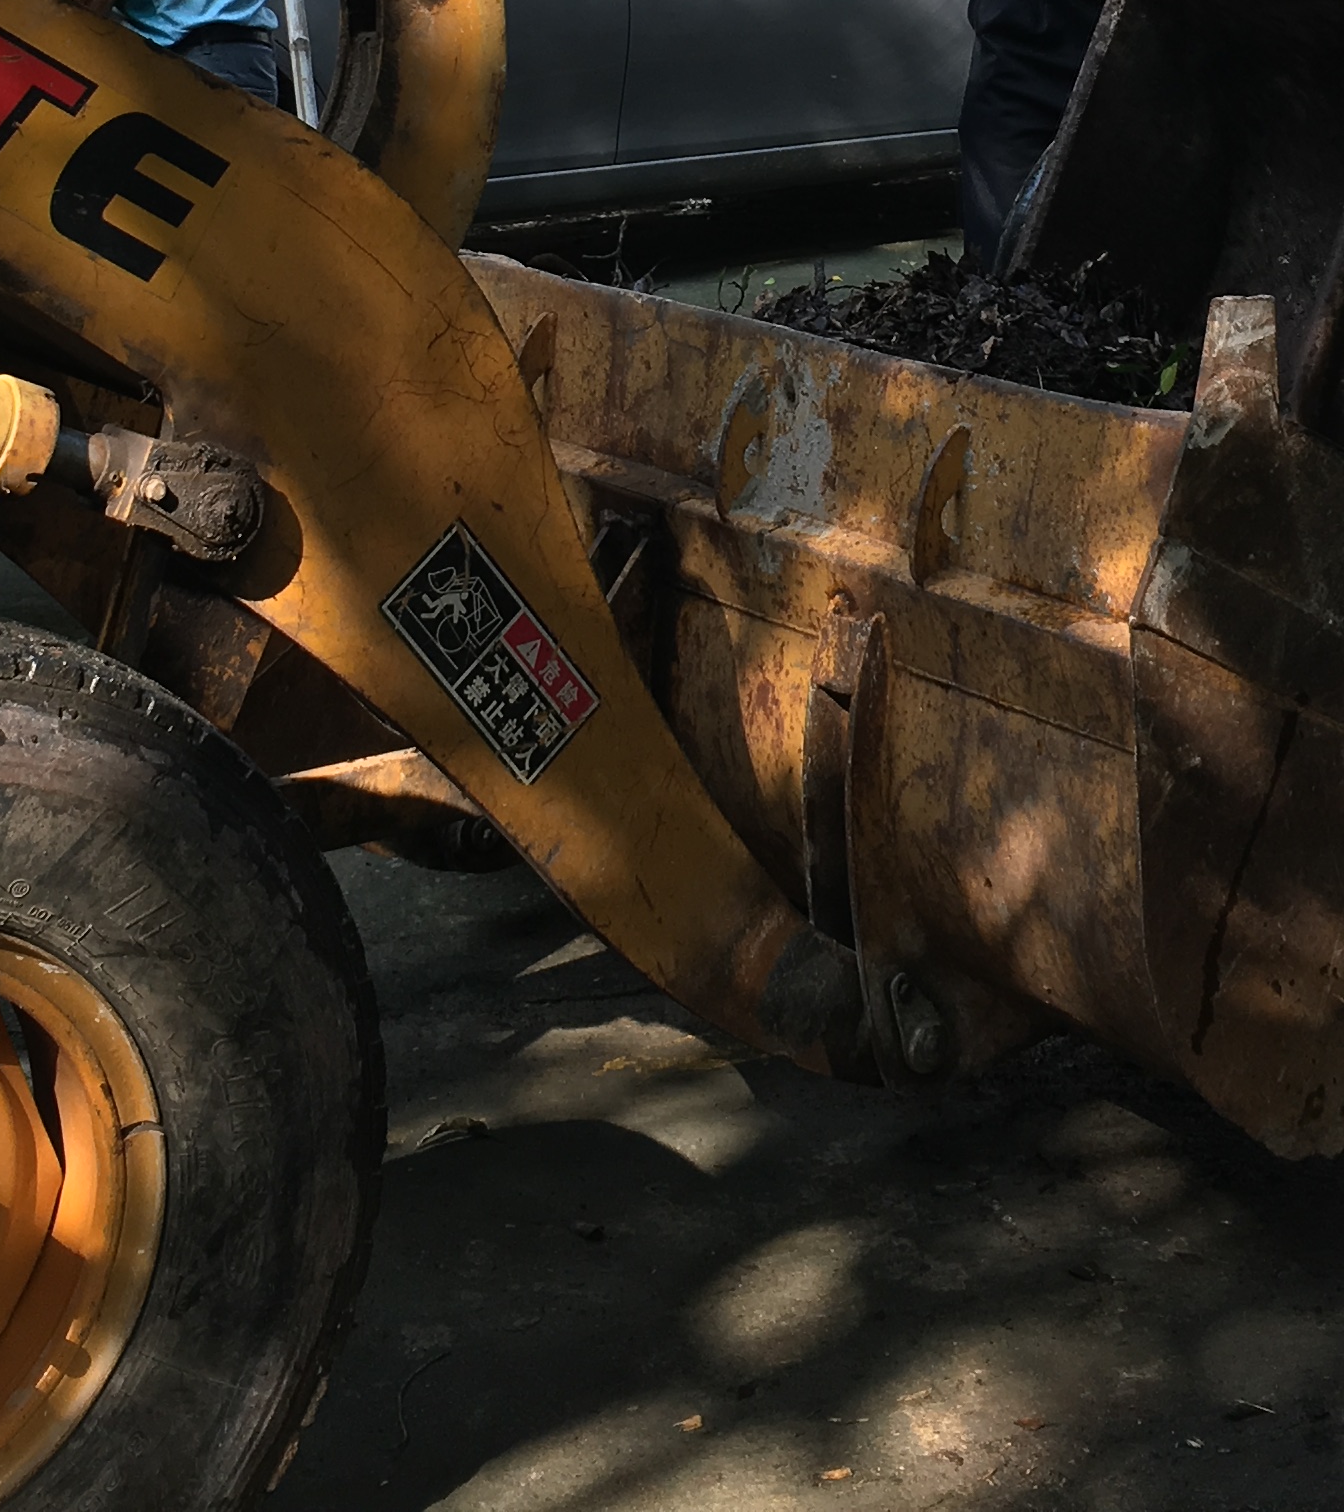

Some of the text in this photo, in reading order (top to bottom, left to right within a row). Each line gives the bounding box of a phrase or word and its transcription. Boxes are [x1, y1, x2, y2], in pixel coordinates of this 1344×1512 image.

[463, 674, 538, 770] 禁止站人
[484, 653, 562, 748] 大臂下面
[539, 659, 578, 708] 危险
